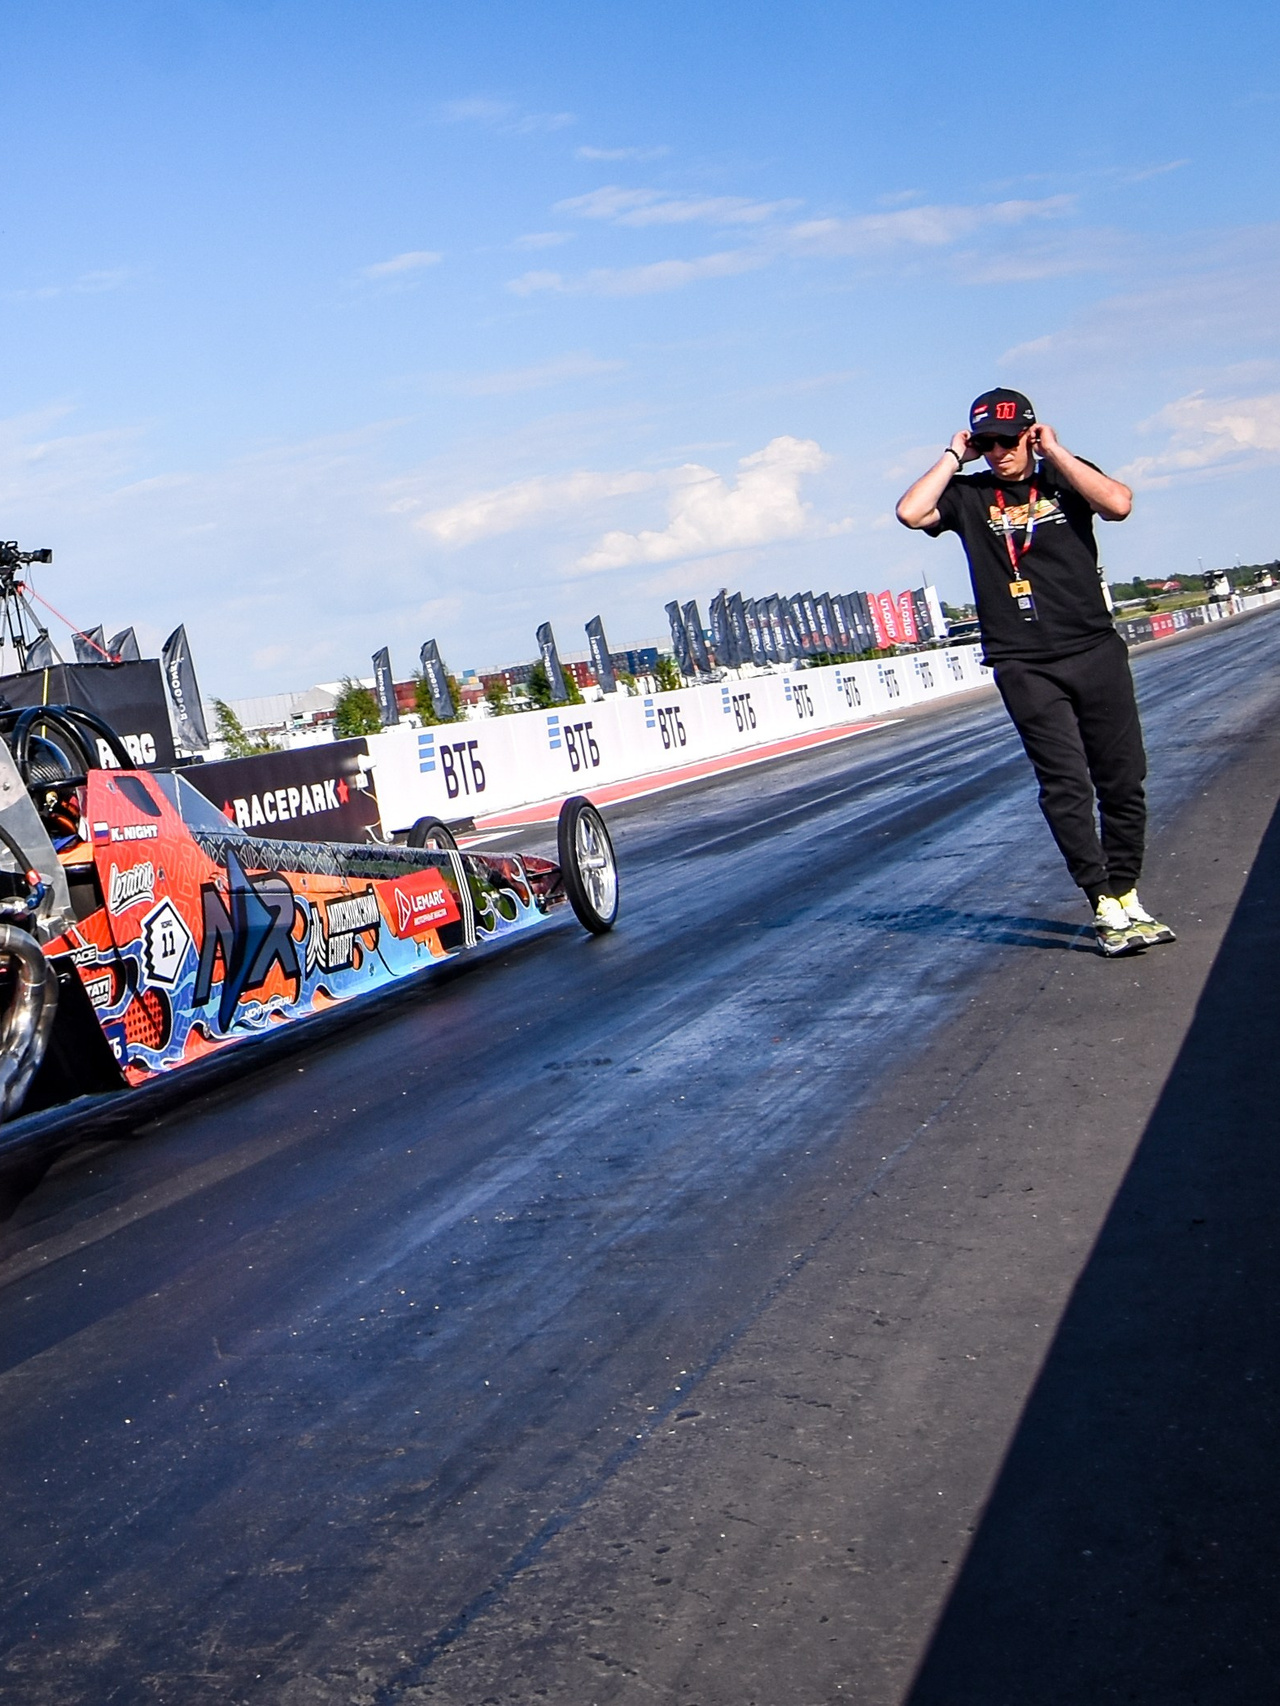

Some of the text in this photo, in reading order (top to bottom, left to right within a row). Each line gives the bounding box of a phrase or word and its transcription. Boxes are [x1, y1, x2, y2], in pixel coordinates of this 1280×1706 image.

[997, 402, 1016, 419] 11
[732, 693, 757, 732] ВТБ
[793, 684, 814, 719] ВТБ
[657, 707, 687, 749] ВТБ
[96, 733, 157, 769] RRC
[564, 722, 600, 772] ВТБ
[440, 740, 486, 799] ВТБ
[233, 779, 339, 829] RACEPARK
[411, 889, 445, 912] LEMARC
[162, 931, 175, 958] 11
[328, 932, 354, 967] СПОРТ
